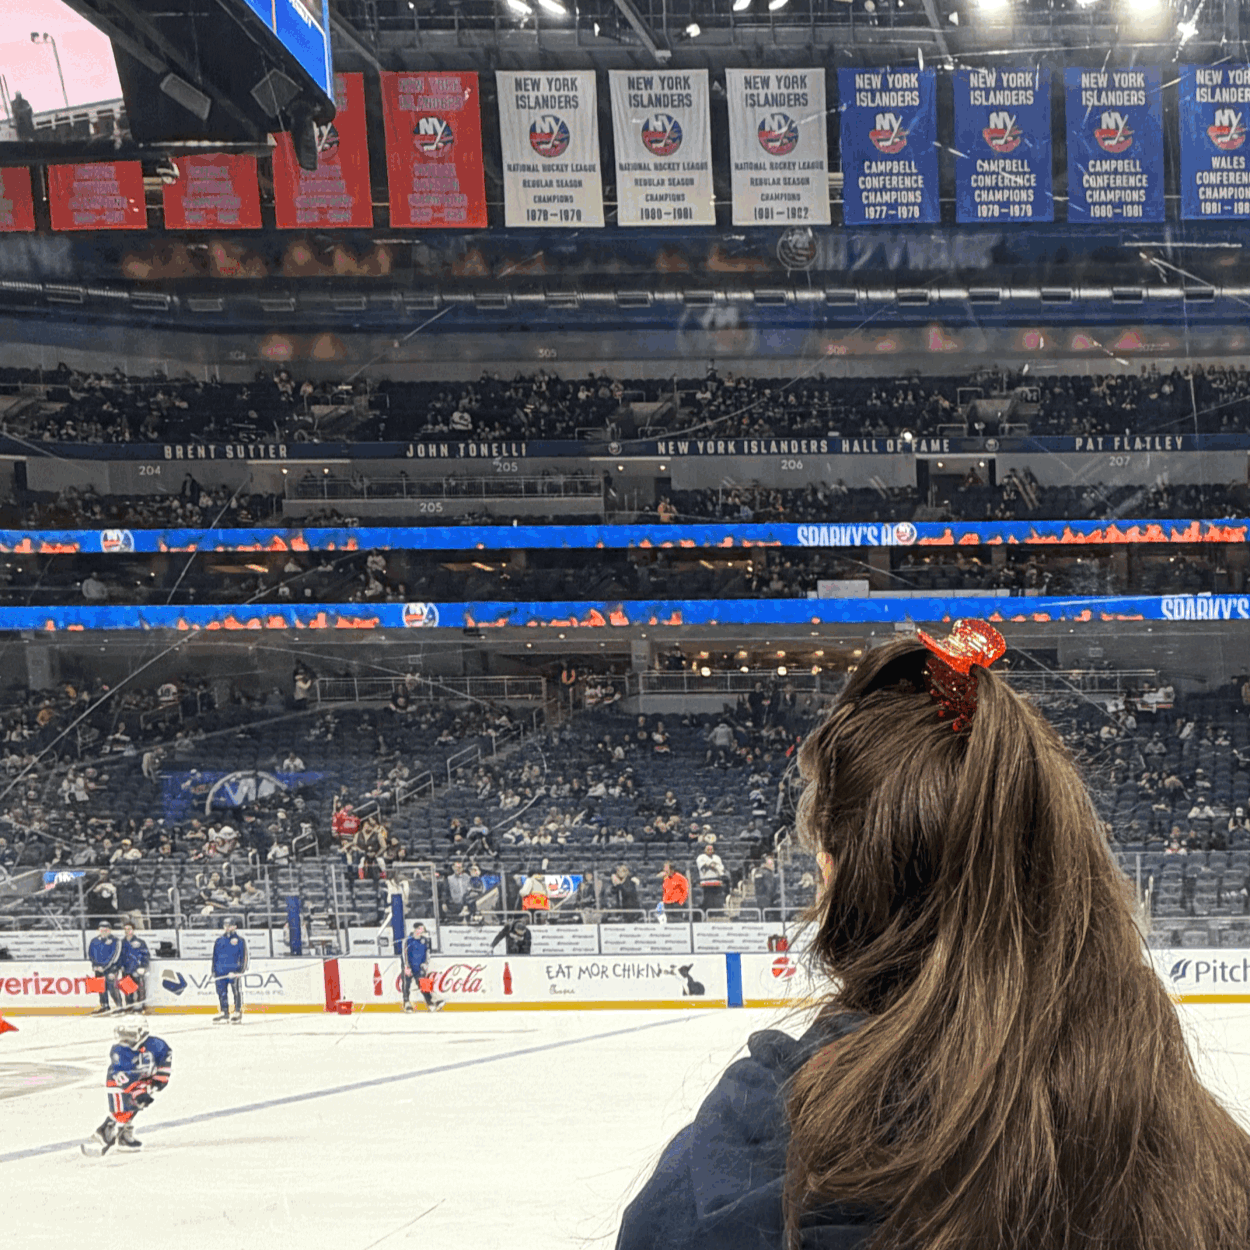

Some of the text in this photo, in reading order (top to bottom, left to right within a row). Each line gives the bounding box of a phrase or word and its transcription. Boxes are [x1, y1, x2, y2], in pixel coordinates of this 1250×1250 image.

[515, 77, 577, 92] NEW YORK
[628, 76, 691, 91] NEW YORK
[744, 75, 807, 90] NEW YORK
[856, 73, 919, 89] NEW YORK
[970, 72, 1033, 88] NEW YORK
[1081, 72, 1144, 88] NEW YORK
[1196, 70, 1221, 85] NEW
[515, 95, 579, 109] ISLANDERS
[628, 93, 692, 108] ISLANDERS
[745, 92, 809, 108] ISLANDERS
[856, 91, 919, 107] ISLANDERS
[970, 90, 1034, 105] ISLANDERS
[1081, 90, 1146, 106] ISLANDERS
[542, 164, 569, 172] HOCKEY
[571, 164, 597, 172] LEAGUE
[654, 162, 680, 171] HOCKEY
[683, 162, 708, 171] LEAGUE
[769, 161, 797, 170] HOCKEY
[800, 161, 824, 170] LEAGUE
[864, 160, 918, 173] CAMPBELL
[976, 159, 1031, 172] CAMPBELL
[1088, 159, 1142, 172] CAMPBELL
[1211, 156, 1246, 169] WALES
[556, 179, 583, 188] SEASON
[668, 178, 694, 186] SEASON
[783, 177, 810, 186] SEASON
[858, 175, 924, 189] CONFERENCE
[971, 174, 1036, 187] CONFERENCE
[1082, 174, 1148, 188] CONFERENCE
[533, 195, 574, 203] CHAMPIONS
[645, 193, 685, 202] CHAMPIONS
[761, 193, 801, 202] CHAMPIONS
[861, 190, 922, 204] CHAMPIONS
[974, 189, 1034, 203] CHAMPIONS
[1086, 190, 1146, 203] CHAMPIONS
[406, 443, 526, 457] JOHN TONELLI
[657, 438, 950, 455] NEW YORK ISLANDERS HALL OF FAME
[1075, 436, 1184, 451] PAT FLATLEY
[164, 444, 287, 459] BRENT SUTTER
[496, 462, 519, 473] 205
[781, 459, 804, 471] 206
[1108, 455, 1131, 468] 207
[138, 465, 161, 476] 204
[420, 502, 443, 513] 205
[545, 963, 661, 980] EAT MOR CHIKIN
[0, 971, 88, 995] erizon
[189, 973, 283, 989] VADA
